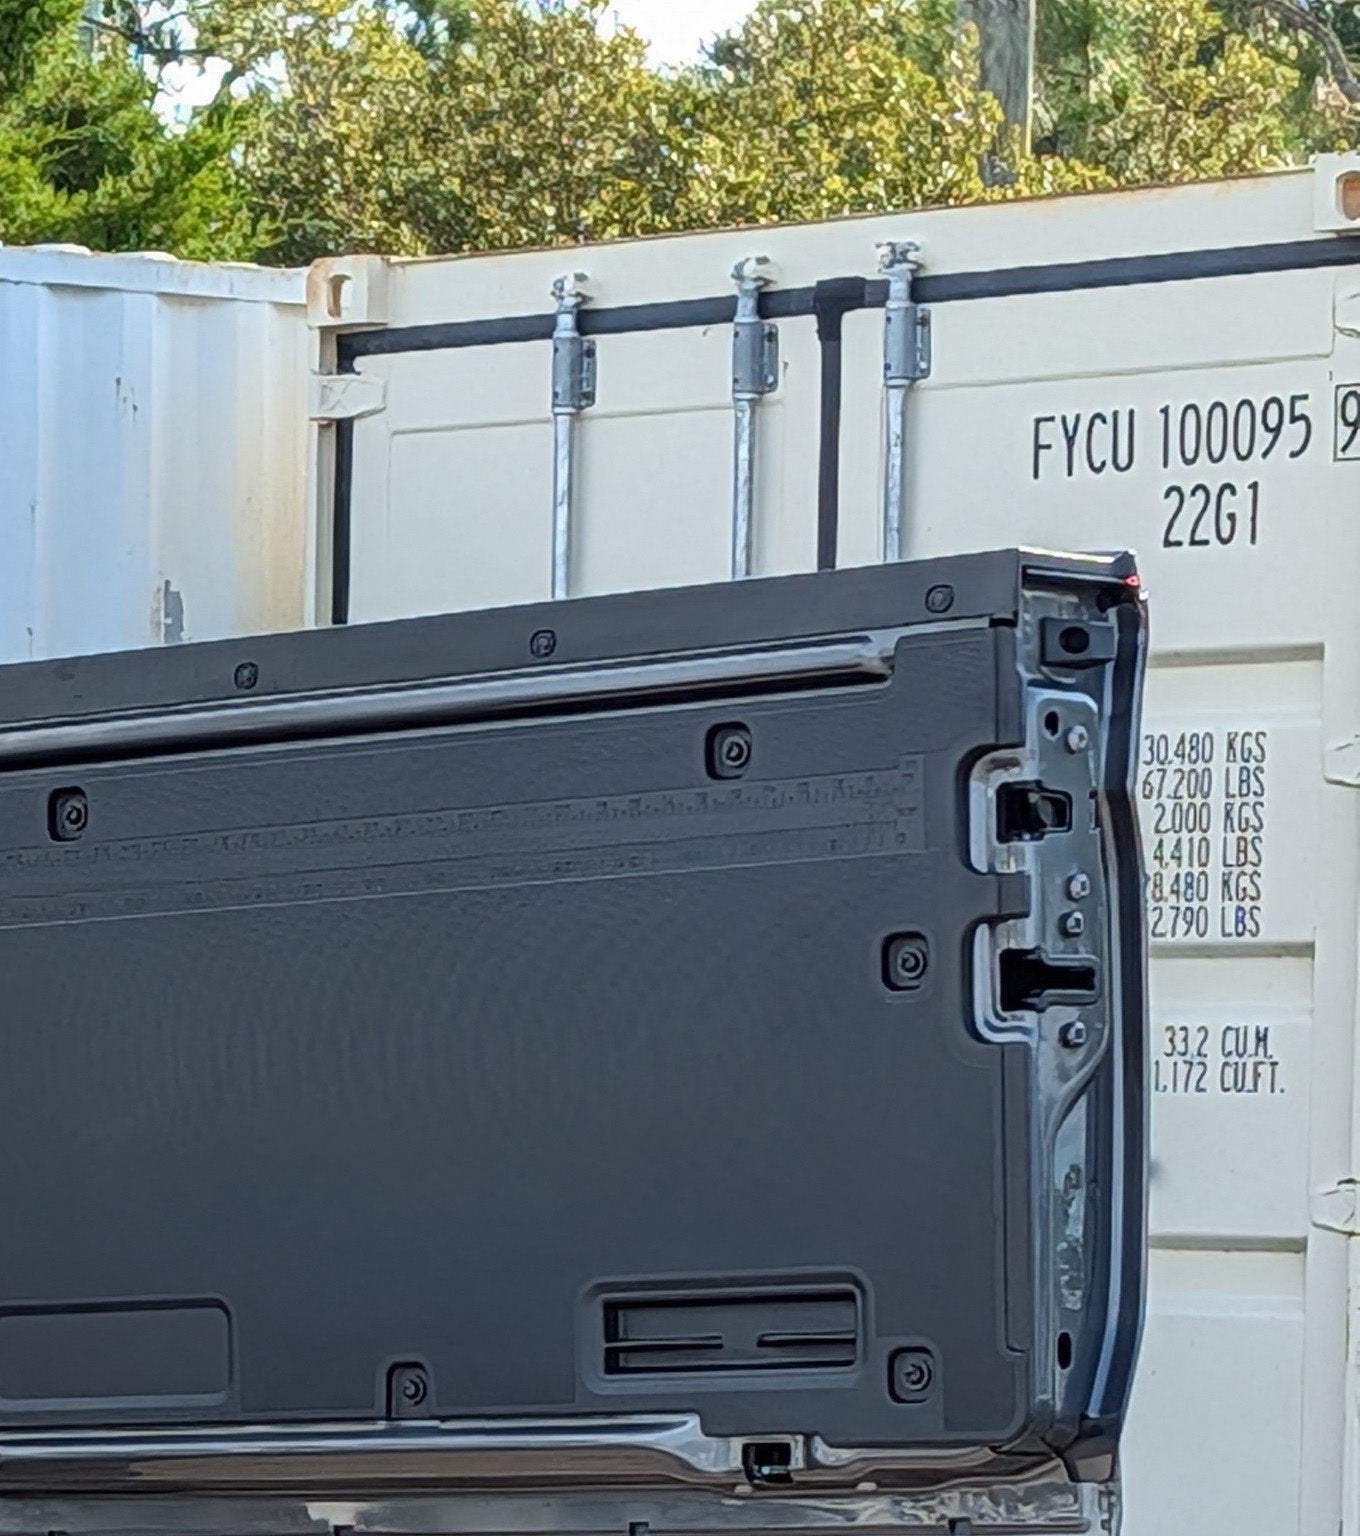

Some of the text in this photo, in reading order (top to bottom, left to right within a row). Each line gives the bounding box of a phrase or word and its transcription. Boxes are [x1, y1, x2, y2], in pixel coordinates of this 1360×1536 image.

[1033, 389, 1360, 479] FYCU 100095 9
[1162, 480, 1259, 548] 22G1
[1225, 731, 1267, 763] KGS
[1225, 766, 1265, 798] LBS
[1223, 801, 1264, 833] KGS
[1222, 835, 1263, 868] LBS
[1221, 870, 1261, 903] KGS
[1221, 904, 1261, 938] LBS
